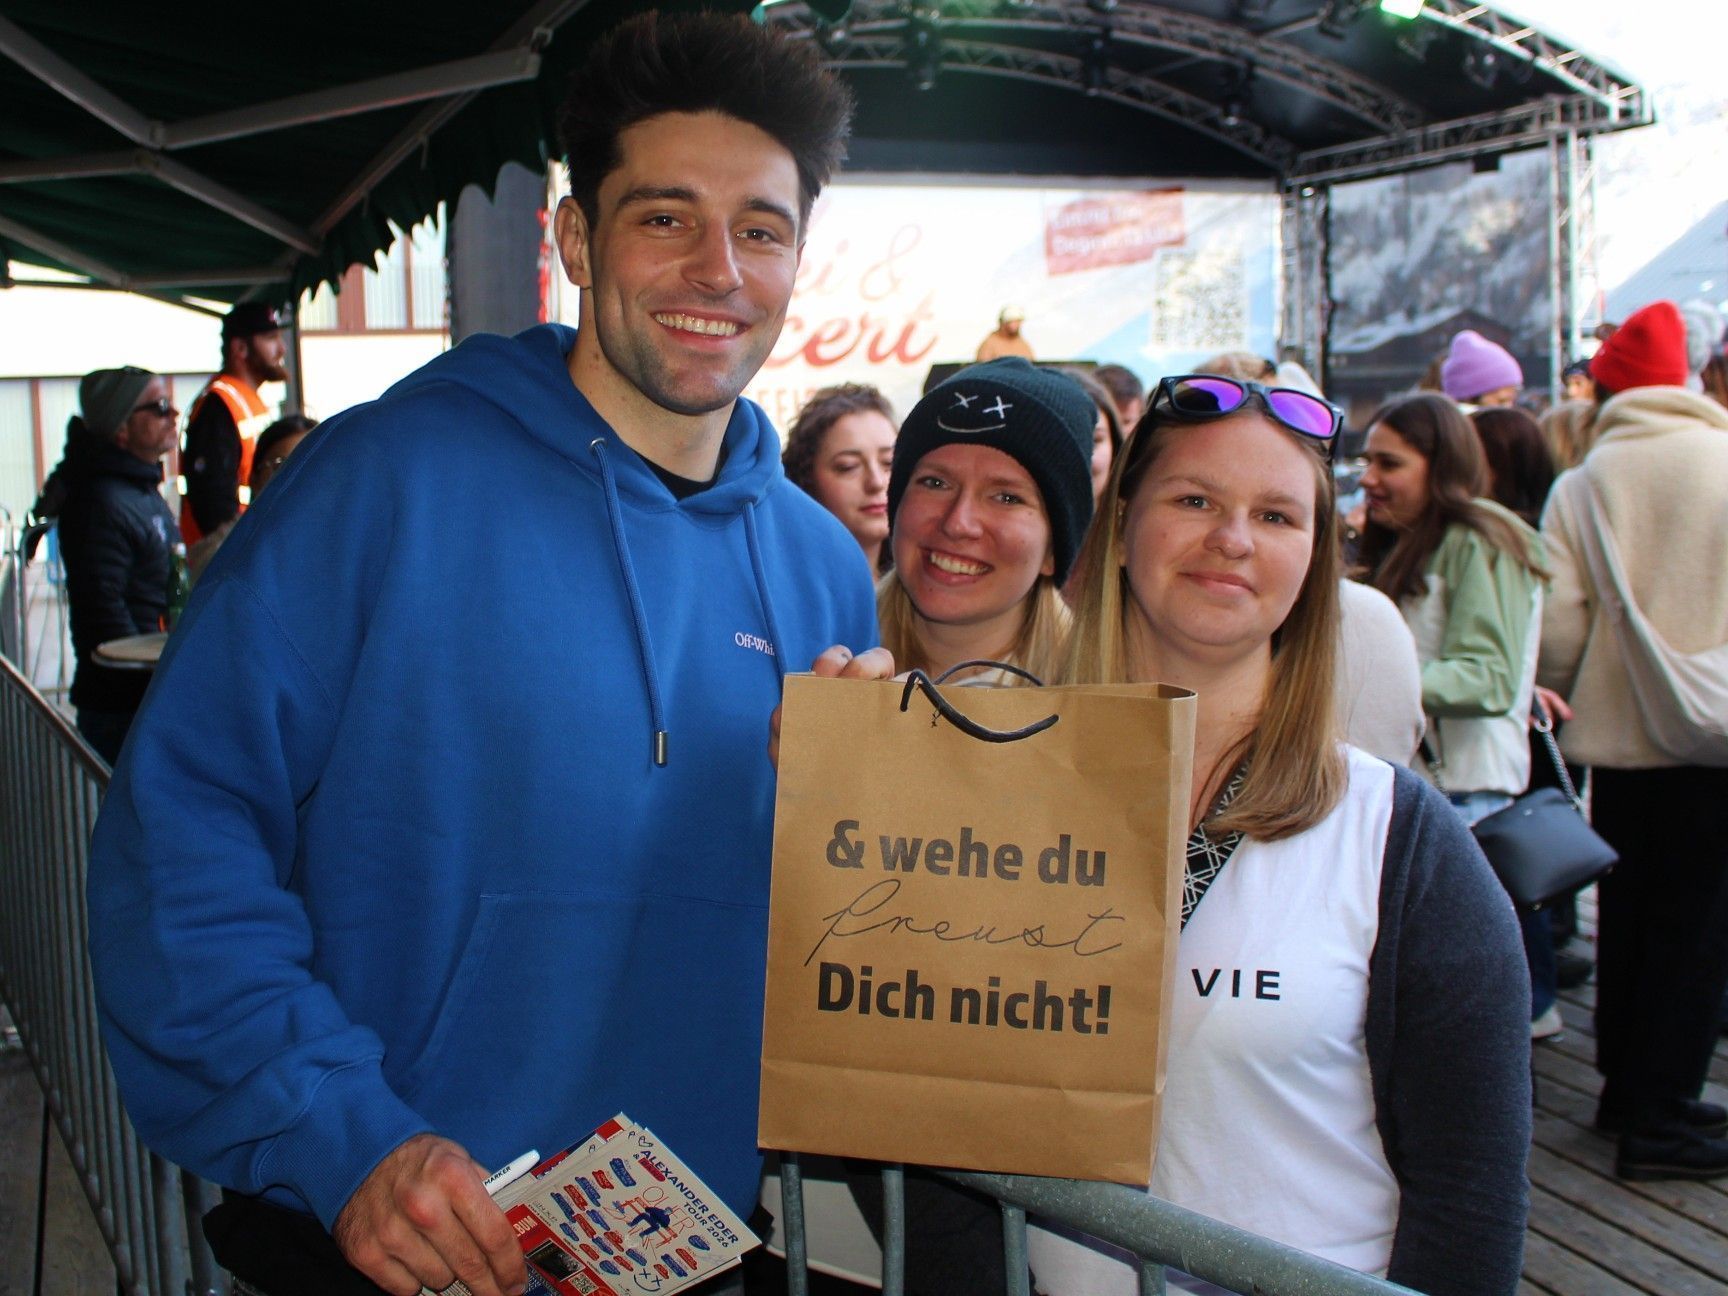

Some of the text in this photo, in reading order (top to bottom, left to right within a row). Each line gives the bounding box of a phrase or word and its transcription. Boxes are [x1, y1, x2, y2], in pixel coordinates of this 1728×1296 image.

[859, 223, 922, 301] &
[765, 288, 938, 367] cert
[734, 631, 775, 657] Off-Whi
[826, 819, 1107, 887] & wehe du
[804, 878, 1125, 967] freust
[817, 961, 1111, 1035] Dich nicht!
[1191, 968, 1281, 1001] VIE
[484, 1166, 511, 1186] MARKER
[640, 1150, 709, 1214] ALEXANDER
[707, 1213, 739, 1244] EDER
[683, 1201, 708, 1226] TOUR
[707, 1226, 729, 1248] 2026
